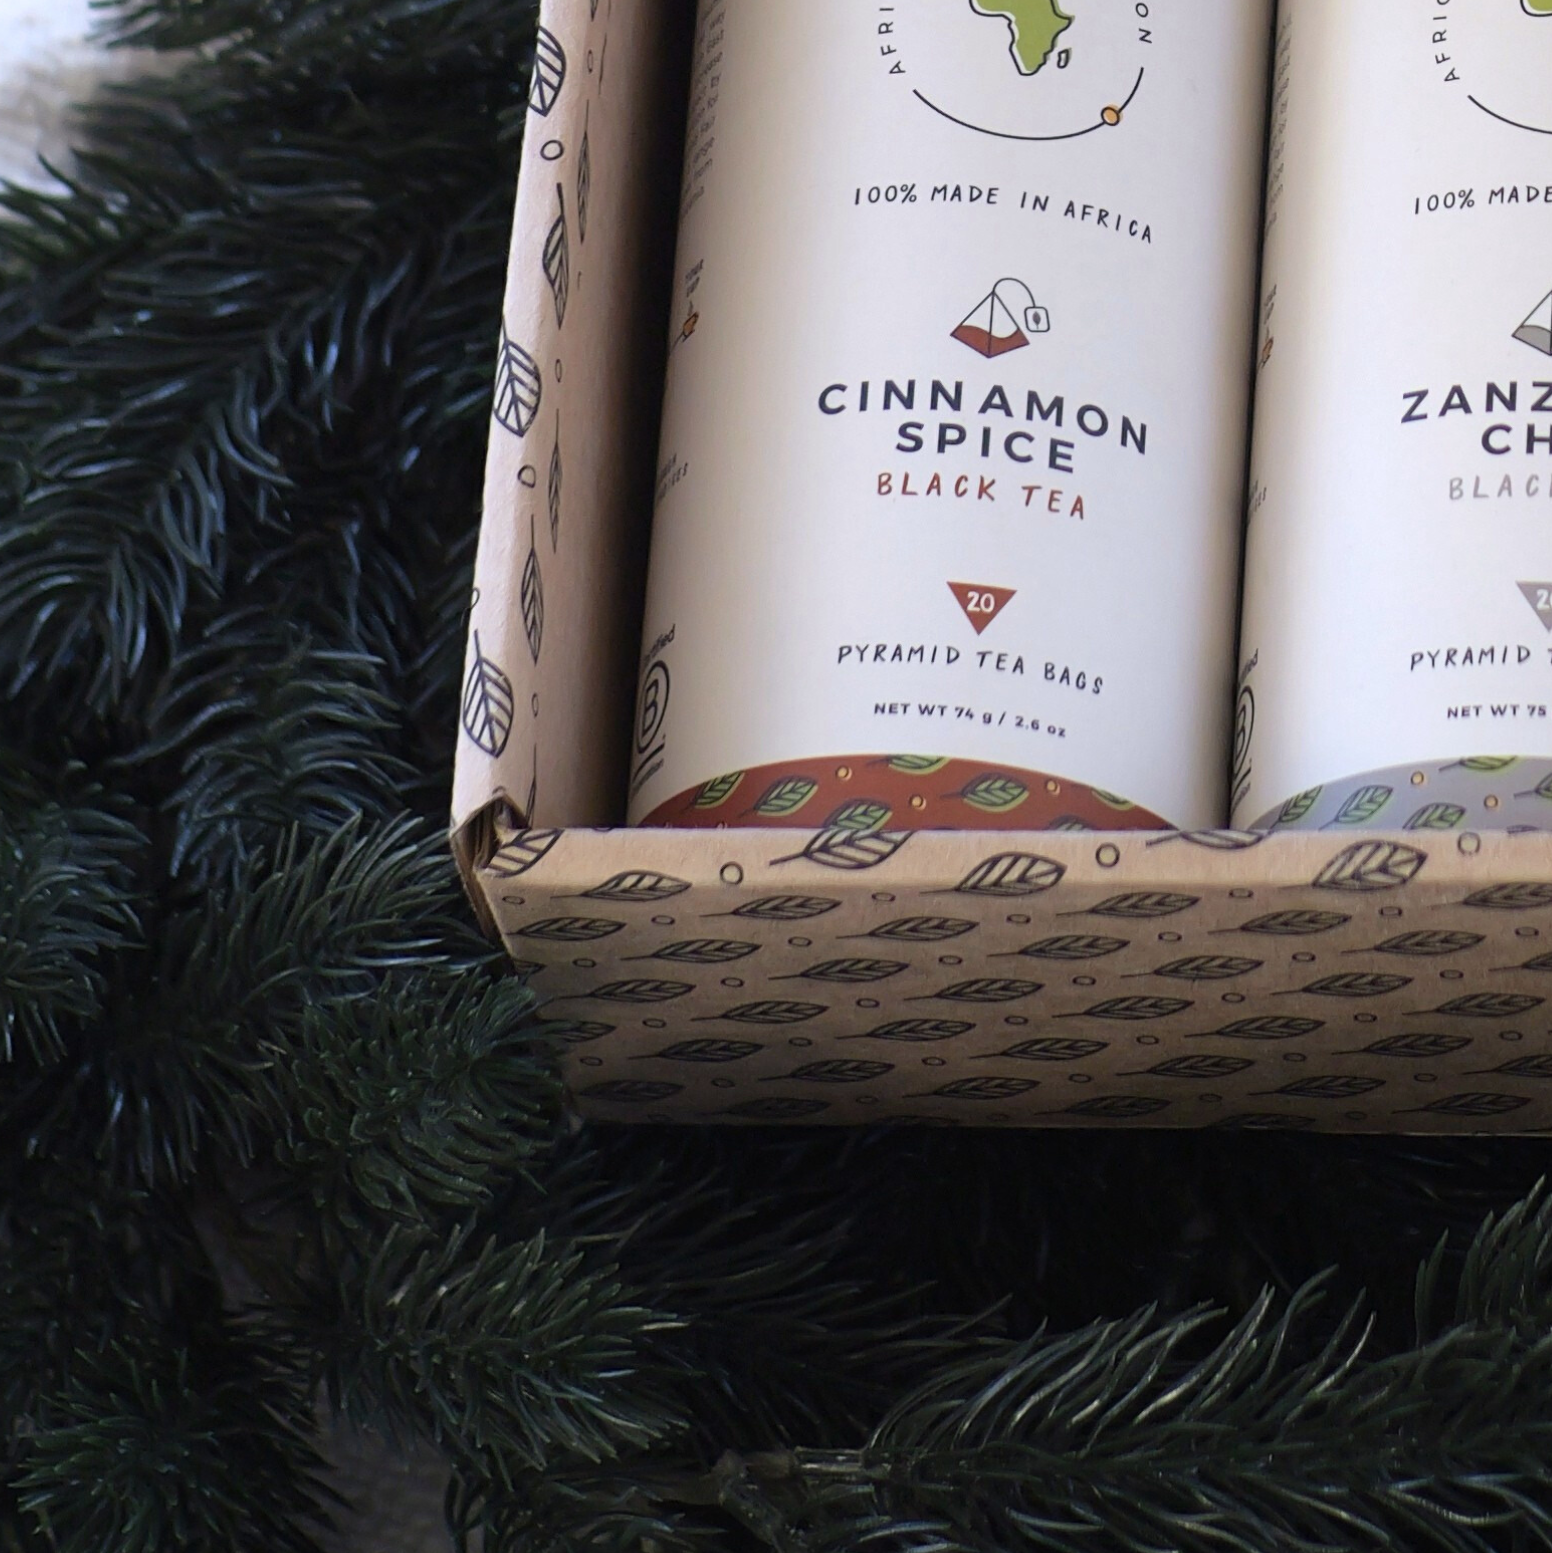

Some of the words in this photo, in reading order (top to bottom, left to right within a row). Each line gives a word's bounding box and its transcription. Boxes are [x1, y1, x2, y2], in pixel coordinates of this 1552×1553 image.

[854, 183, 917, 206] 100%
[931, 184, 999, 205] MADE
[1020, 191, 1049, 212] IN
[1063, 200, 1151, 244] AFRICA
[1415, 188, 1475, 215] 100%
[818, 379, 1147, 458] CINNAMON
[895, 421, 1075, 474] SPICE
[877, 472, 996, 502] BLACK
[1021, 485, 1084, 520] TEA
[967, 592, 995, 612] 20
[837, 644, 960, 665] PYRAMID
[976, 650, 1024, 675] TEA
[1044, 662, 1103, 695] BAGS
[1410, 645, 1531, 672] PYRAMID
[874, 703, 911, 715] NET
[918, 703, 948, 717] WT
[955, 706, 974, 720] 74
[982, 712, 992, 725] g
[998, 711, 1006, 726] /
[1015, 716, 1039, 731] 2.6
[1447, 705, 1482, 719] NET
[1490, 704, 1520, 717] WT
[1527, 704, 1546, 718] 75
